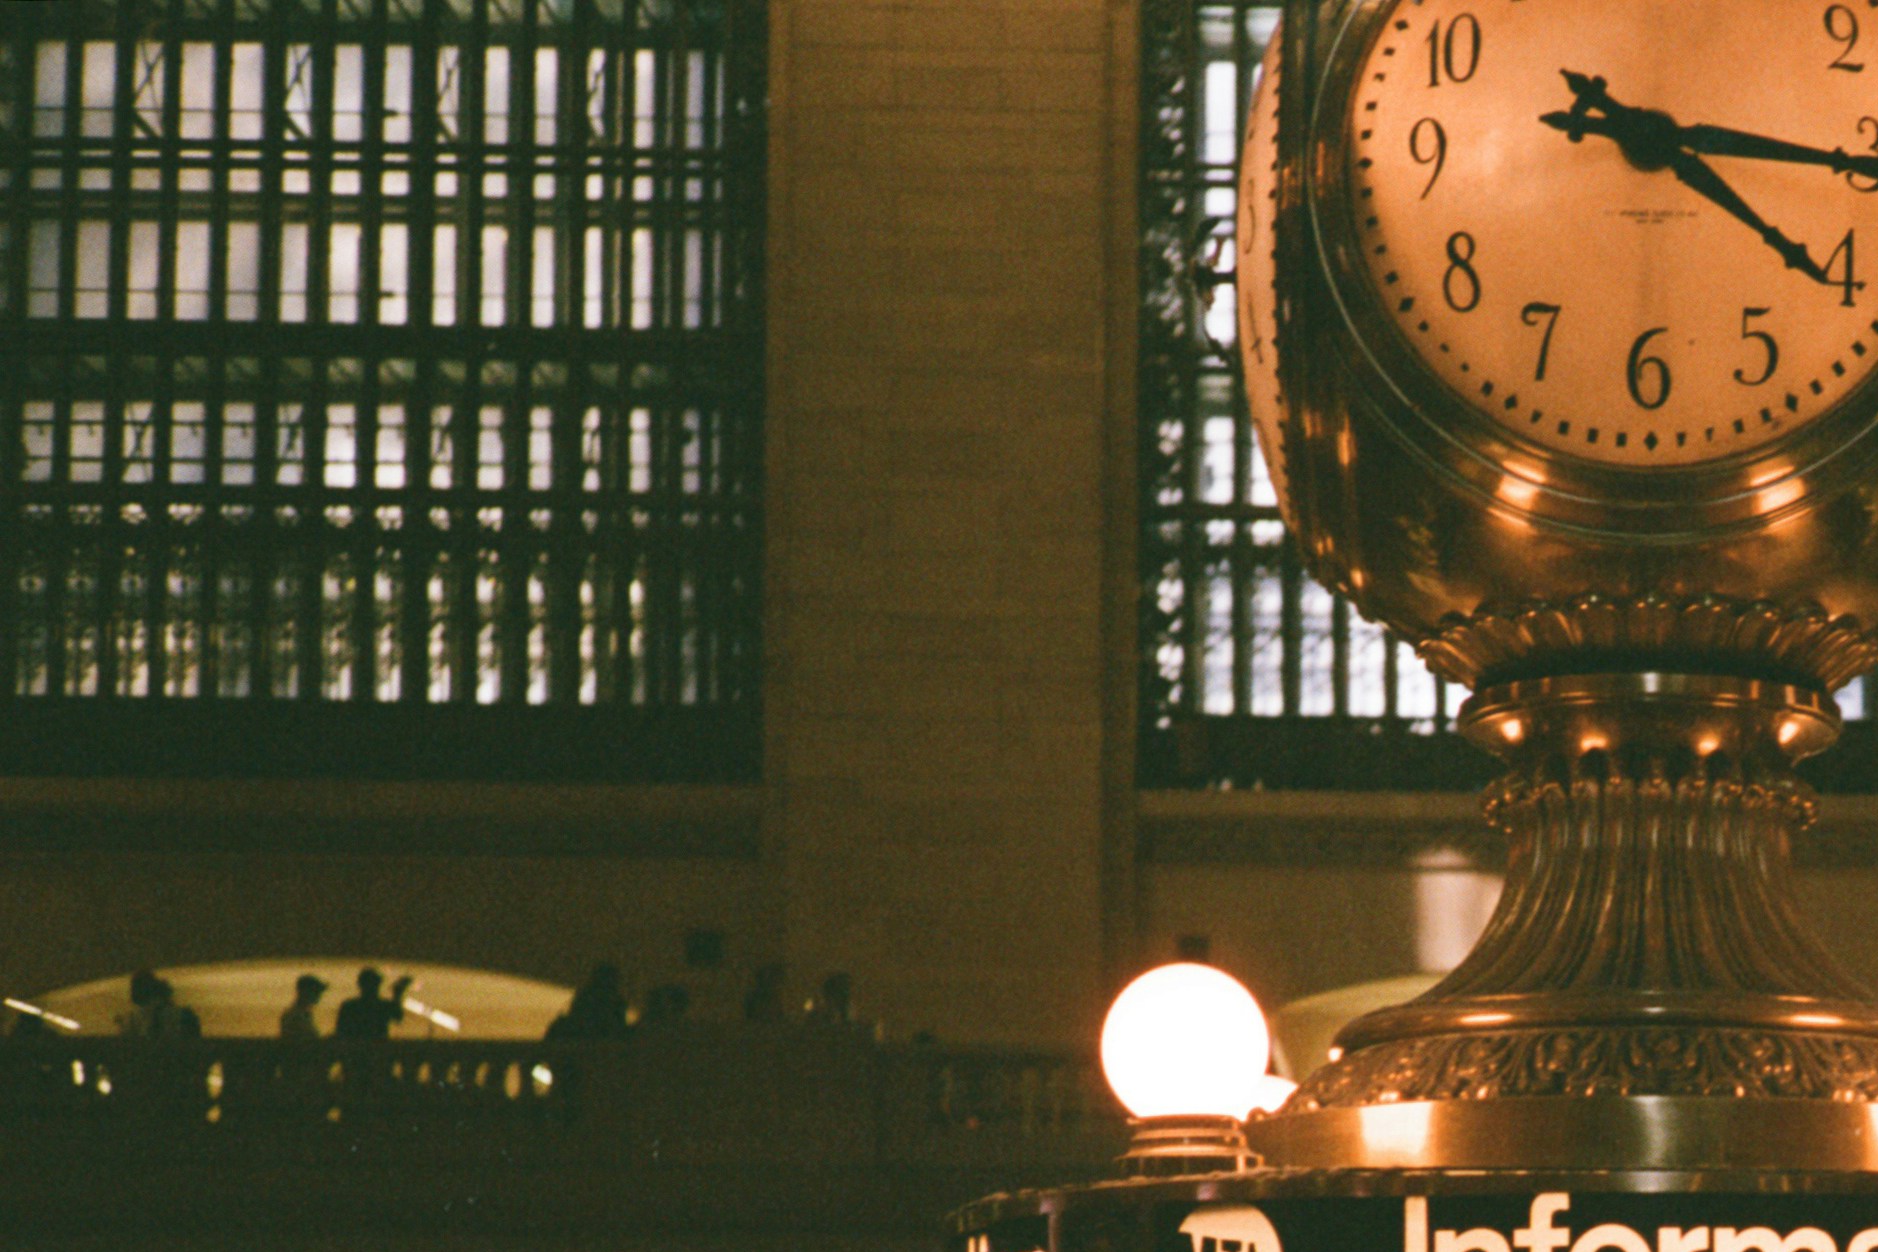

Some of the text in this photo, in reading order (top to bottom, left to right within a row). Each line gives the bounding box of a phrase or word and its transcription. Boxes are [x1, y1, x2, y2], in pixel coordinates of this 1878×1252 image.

[1423, 10, 1484, 90] 10
[1821, 2, 1867, 75] 2
[1407, 115, 1450, 203] 9
[1440, 229, 1484, 315] 8
[1822, 227, 1867, 308] 4
[1518, 300, 1563, 384] 7
[1624, 325, 1674, 412] 6
[1731, 305, 1782, 388] 5
